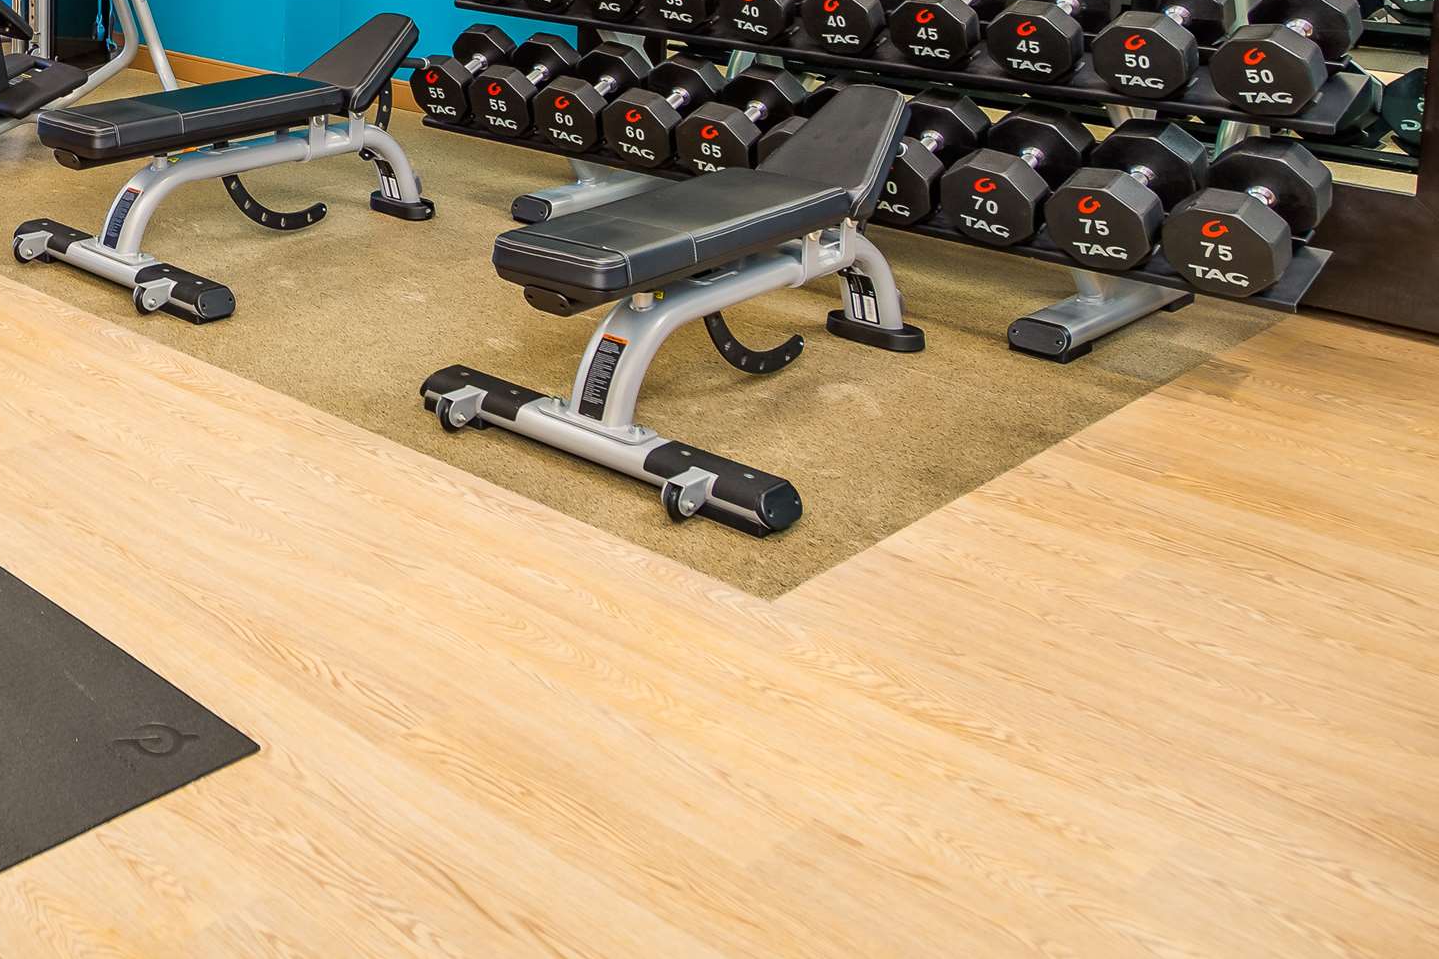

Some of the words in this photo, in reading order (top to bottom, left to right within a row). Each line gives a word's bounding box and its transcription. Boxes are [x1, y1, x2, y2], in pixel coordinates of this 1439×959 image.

[659, 8, 693, 24] TAG
[741, 4, 760, 18] 40
[733, 18, 768, 36] TAG
[827, 15, 846, 28] 40
[821, 33, 860, 45] TAG
[916, 27, 938, 41] 45
[908, 44, 951, 59] TAG
[1016, 39, 1040, 54] 45
[1006, 57, 1052, 74] TAG
[1124, 53, 1150, 69] 50
[1114, 73, 1165, 90] TAG
[1245, 69, 1274, 84] 50
[428, 87, 445, 99] 55
[1238, 91, 1293, 104] TAG
[426, 104, 457, 116] TAG
[489, 98, 507, 112] 55
[485, 114, 518, 130] TAG
[555, 112, 574, 127] 60
[548, 127, 584, 146] TAG
[625, 125, 645, 141] 60
[618, 141, 655, 161] TAG
[701, 142, 722, 158] 65
[886, 181, 898, 195] 0
[877, 200, 911, 217] AG
[971, 195, 999, 215] 70
[959, 213, 1010, 238] TAG
[1078, 218, 1110, 236] 75
[1072, 241, 1128, 260] TAG
[1200, 241, 1233, 261] 75
[1188, 263, 1250, 288] TAG
